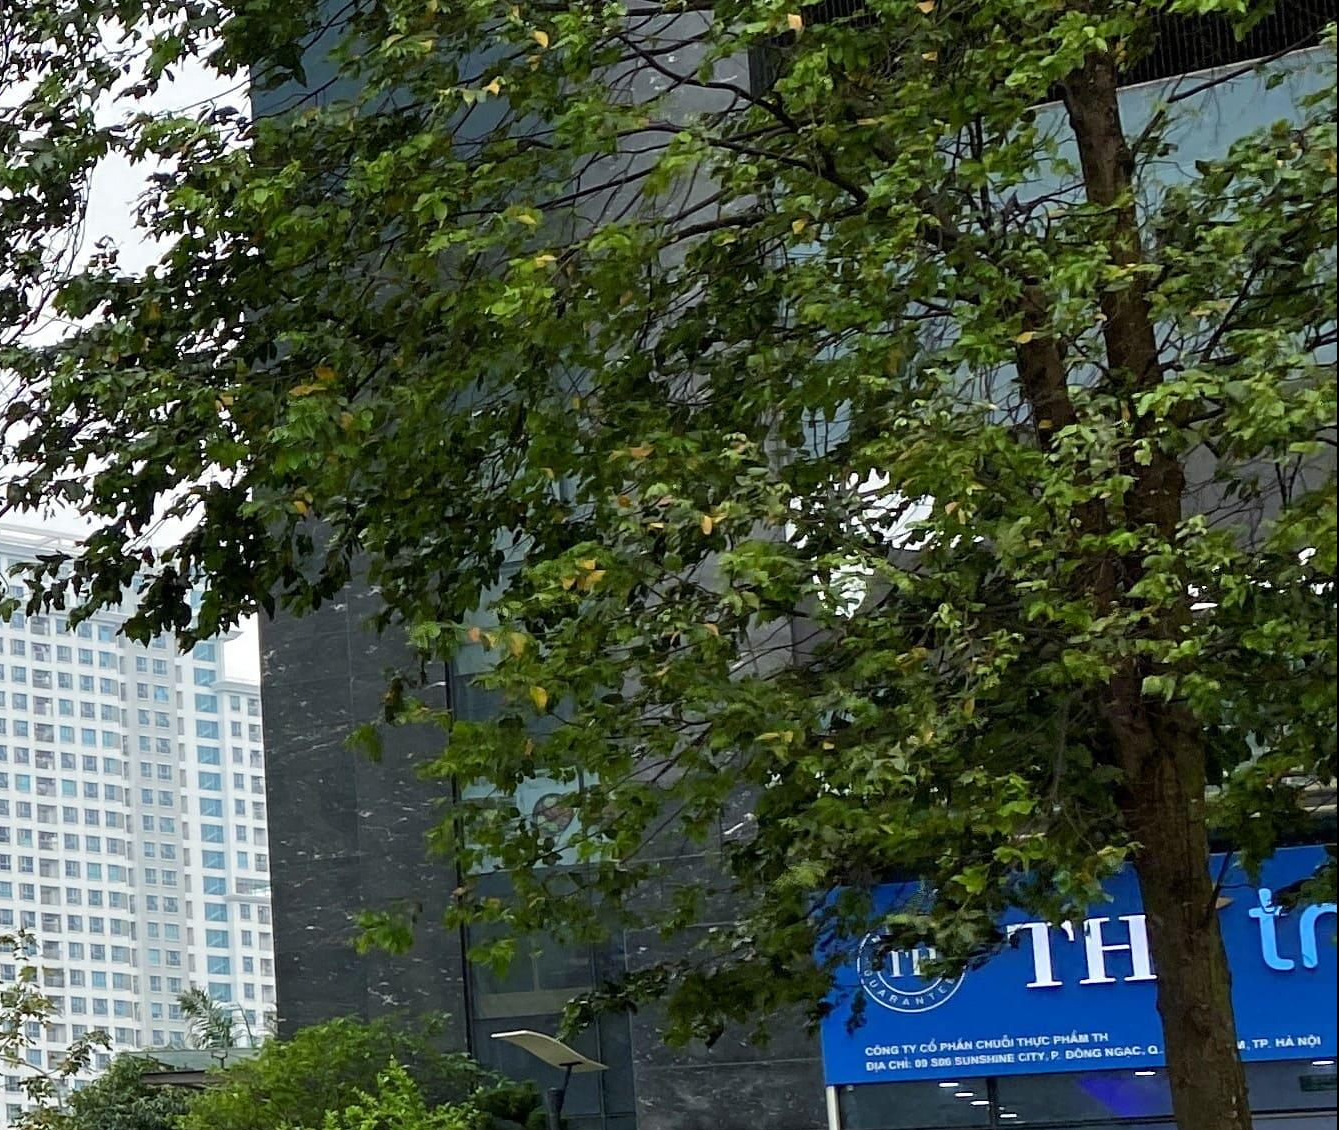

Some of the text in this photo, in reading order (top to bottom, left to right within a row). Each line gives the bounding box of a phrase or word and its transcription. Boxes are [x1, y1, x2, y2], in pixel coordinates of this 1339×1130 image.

[1005, 914, 1158, 988] TH
[865, 1044, 899, 1056] CÔNG
[902, 1044, 917, 1054] TY
[1016, 1036, 1050, 1048] THỰC
[1091, 1032, 1109, 1042] TH
[1275, 1035, 1295, 1047] HÀ
[1297, 1034, 1321, 1049] NỘI
[954, 1053, 1015, 1066] SUNSHINE
